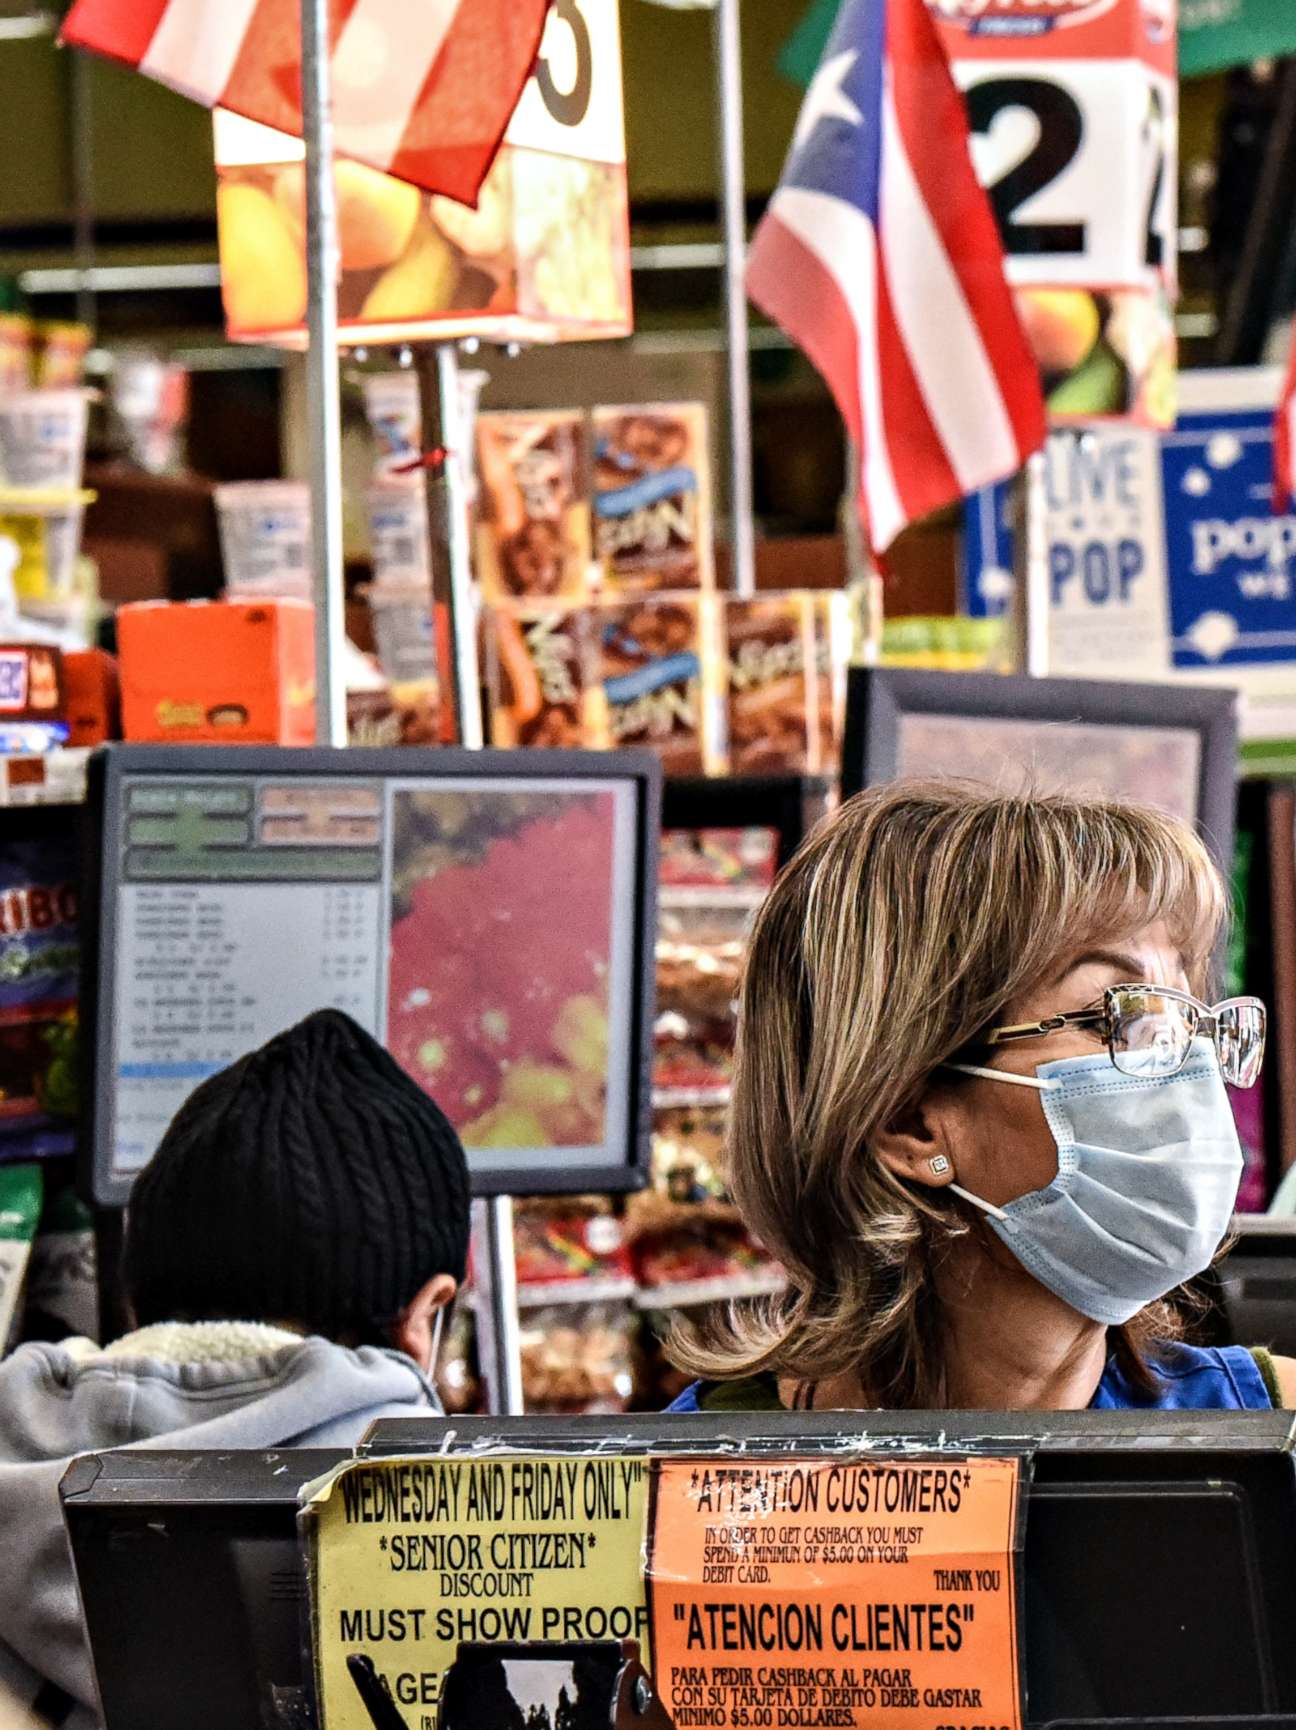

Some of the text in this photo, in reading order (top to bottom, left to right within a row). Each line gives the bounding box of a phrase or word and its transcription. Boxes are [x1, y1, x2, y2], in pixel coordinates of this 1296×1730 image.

[965, 79, 1085, 254] 2
[1050, 539, 1144, 605] POP
[1239, 572, 1289, 600] WE
[467, 1463, 505, 1522] AND
[511, 1463, 578, 1521] FRIDAY
[583, 1461, 642, 1520] ONLY"
[705, 1526, 924, 1544] IN ORDER TO GET CASHBACK YOU MUST
[703, 1545, 740, 1564] SPEND
[741, 1545, 750, 1564] A
[804, 1545, 821, 1564] OF
[822, 1545, 855, 1564] $5.00
[857, 1545, 875, 1564] ON
[877, 1545, 909, 1564] YOUR
[439, 1572, 535, 1597] DISCOUNT
[702, 1565, 772, 1583] DEBIT CARD.
[933, 1569, 1000, 1591] THANK YOU
[340, 1605, 649, 1642] MUST SHOW PROOF
[673, 1603, 975, 1652] "ATENCION CLIENTES"
[671, 1667, 912, 1688] PARA PEDIR CASHBACK AL PAGAR
[671, 1687, 982, 1708] CON SU TARJETA DE DEBITO DEBE GASTAR
[672, 1707, 858, 1728] MINIMO $5.00 DOLLARES.
